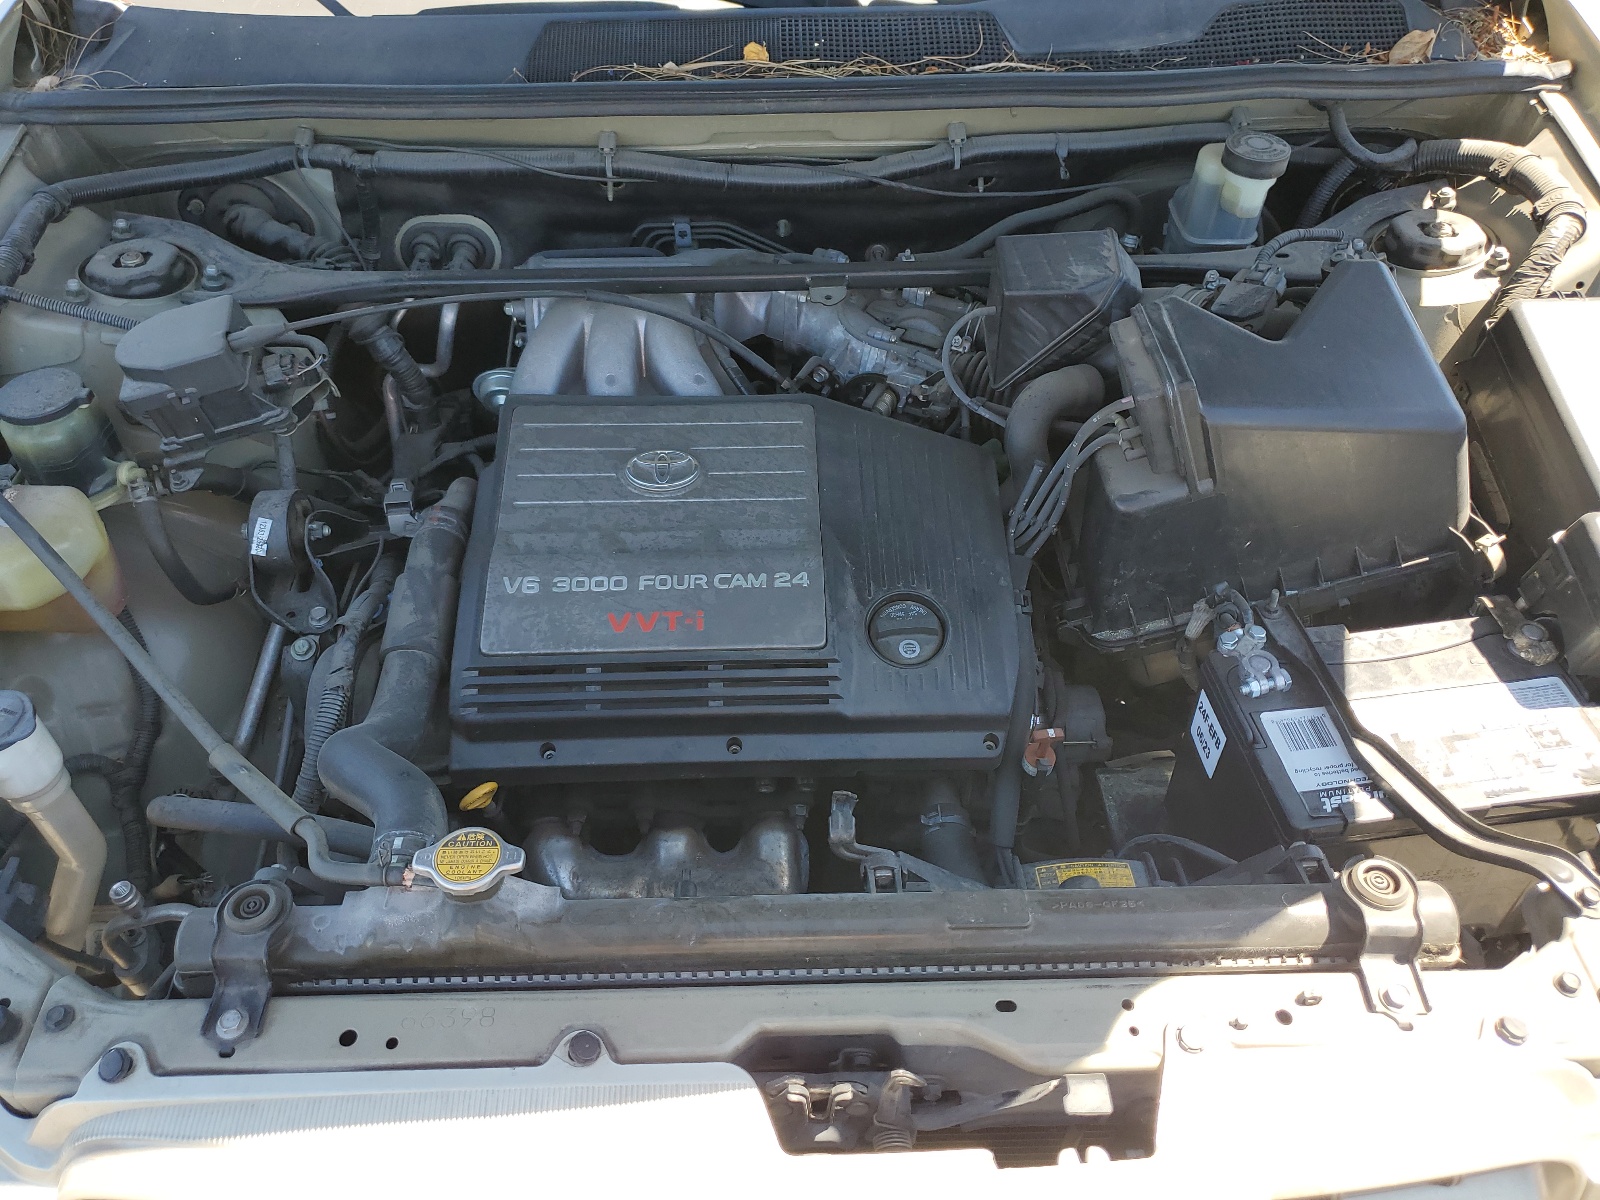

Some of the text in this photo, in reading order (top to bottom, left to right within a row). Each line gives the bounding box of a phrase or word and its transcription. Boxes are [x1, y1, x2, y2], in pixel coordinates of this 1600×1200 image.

[502, 571, 810, 594] V6 3000 FOUR CAM 24
[607, 609, 705, 633] VVT-i
[1198, 700, 1221, 750] 24F-EFB
[448, 840, 493, 848] CAUTION
